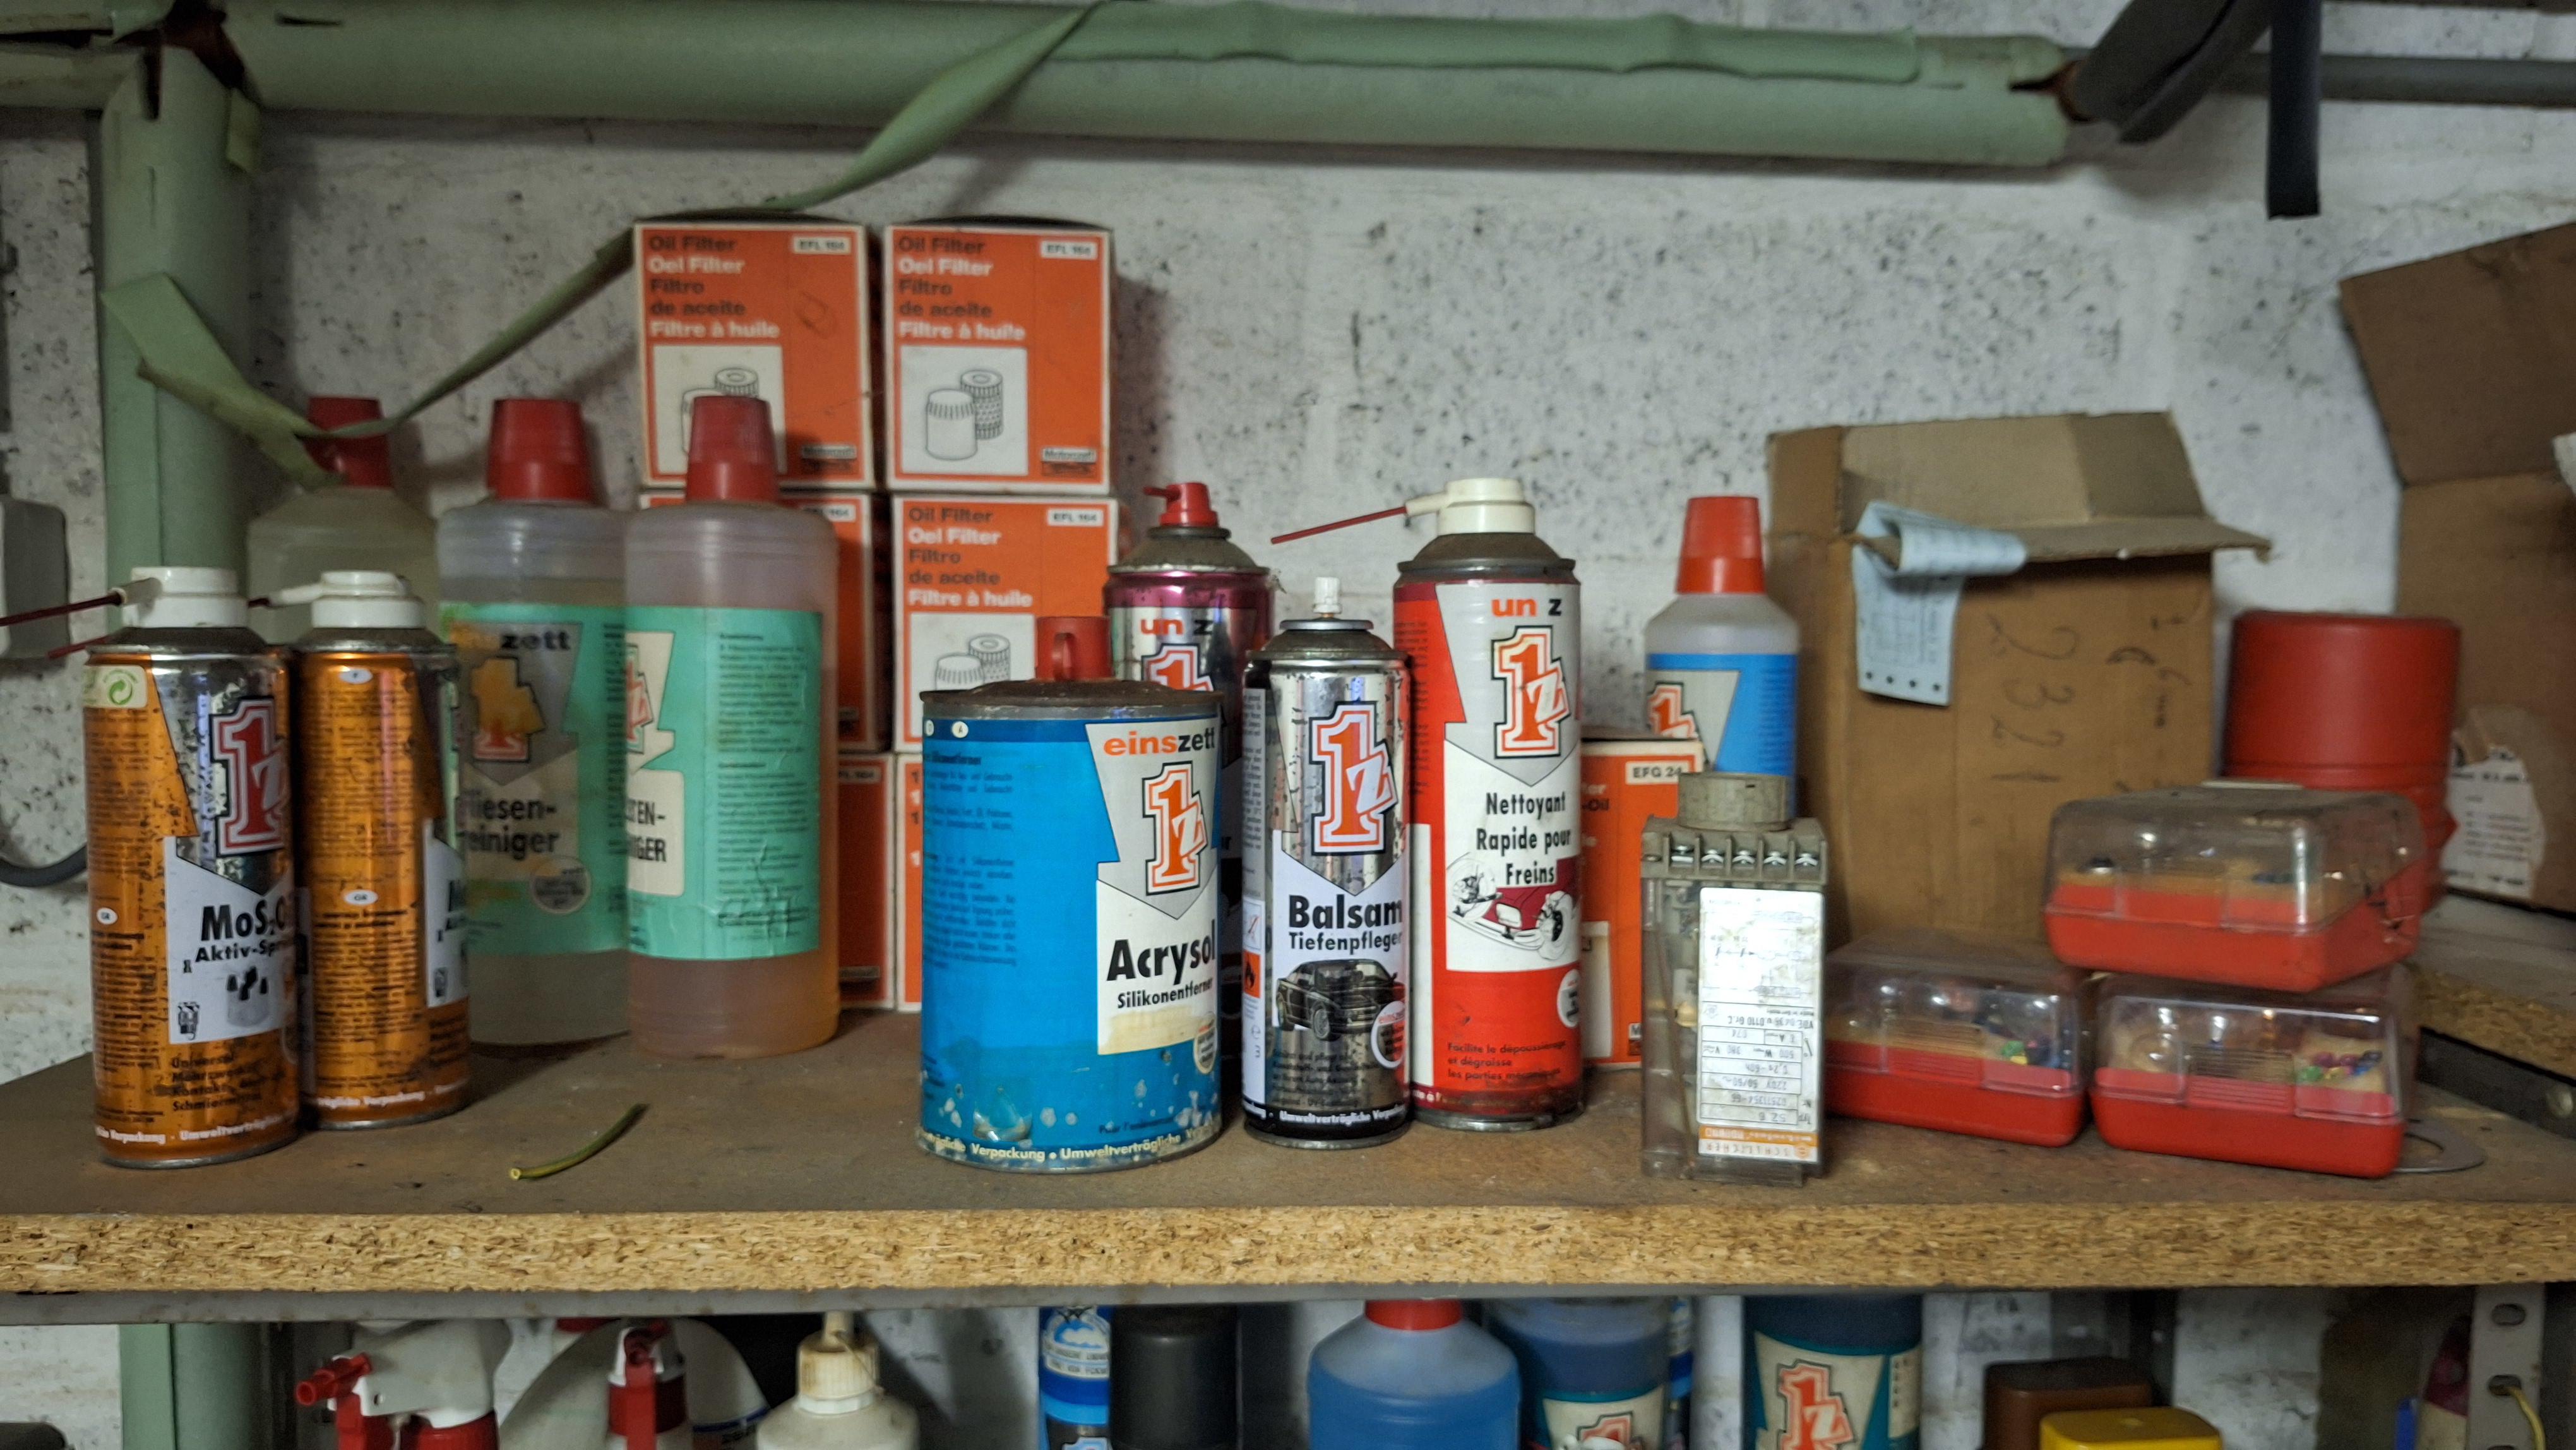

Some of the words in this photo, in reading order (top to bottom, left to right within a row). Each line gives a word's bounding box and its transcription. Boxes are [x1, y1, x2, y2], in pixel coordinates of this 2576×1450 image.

[649, 236, 676, 251] Oil
[683, 237, 736, 251] Filter
[899, 236, 925, 252] Oil
[933, 237, 985, 253] Filter
[648, 255, 684, 273] Oel
[688, 256, 745, 274] Filter
[898, 257, 934, 275] Oel
[939, 258, 993, 276] Filter
[650, 279, 704, 294] Filtro
[899, 279, 953, 295] Filtro
[651, 301, 676, 315] de
[683, 301, 746, 315] aceite
[900, 301, 924, 316] de
[930, 301, 993, 318] aceite
[650, 320, 707, 338] Filtre
[712, 321, 724, 338] à
[730, 320, 780, 339] huile
[899, 320, 953, 339] Filtre
[960, 321, 972, 339] à
[977, 322, 1026, 340] huile
[909, 507, 934, 523] Oil
[941, 507, 993, 523] Filter
[908, 527, 943, 545] Oel
[948, 528, 1001, 546] Filter
[909, 549, 961, 565] Filtro
[909, 570, 933, 585] de
[939, 571, 1001, 585] aceite
[908, 589, 962, 606] Filtre
[967, 589, 979, 606] à
[984, 589, 1033, 607] huile
[1491, 597, 1537, 618] un
[1549, 598, 1562, 617] z
[1141, 619, 1183, 635] un
[1104, 728, 1215, 756] einszett
[1632, 767, 1661, 779] EFG
[1486, 791, 1566, 820] Nettoyant
[1476, 828, 1537, 856] Rapide
[1545, 829, 1571, 853] pour
[1506, 861, 1555, 885] Freins
[1288, 894, 1403, 930] Balsam
[1107, 919, 1215, 986] Acrysol
[1460, 1056, 1512, 1068] dégraisse
[971, 1142, 1046, 1162] Verpackung
